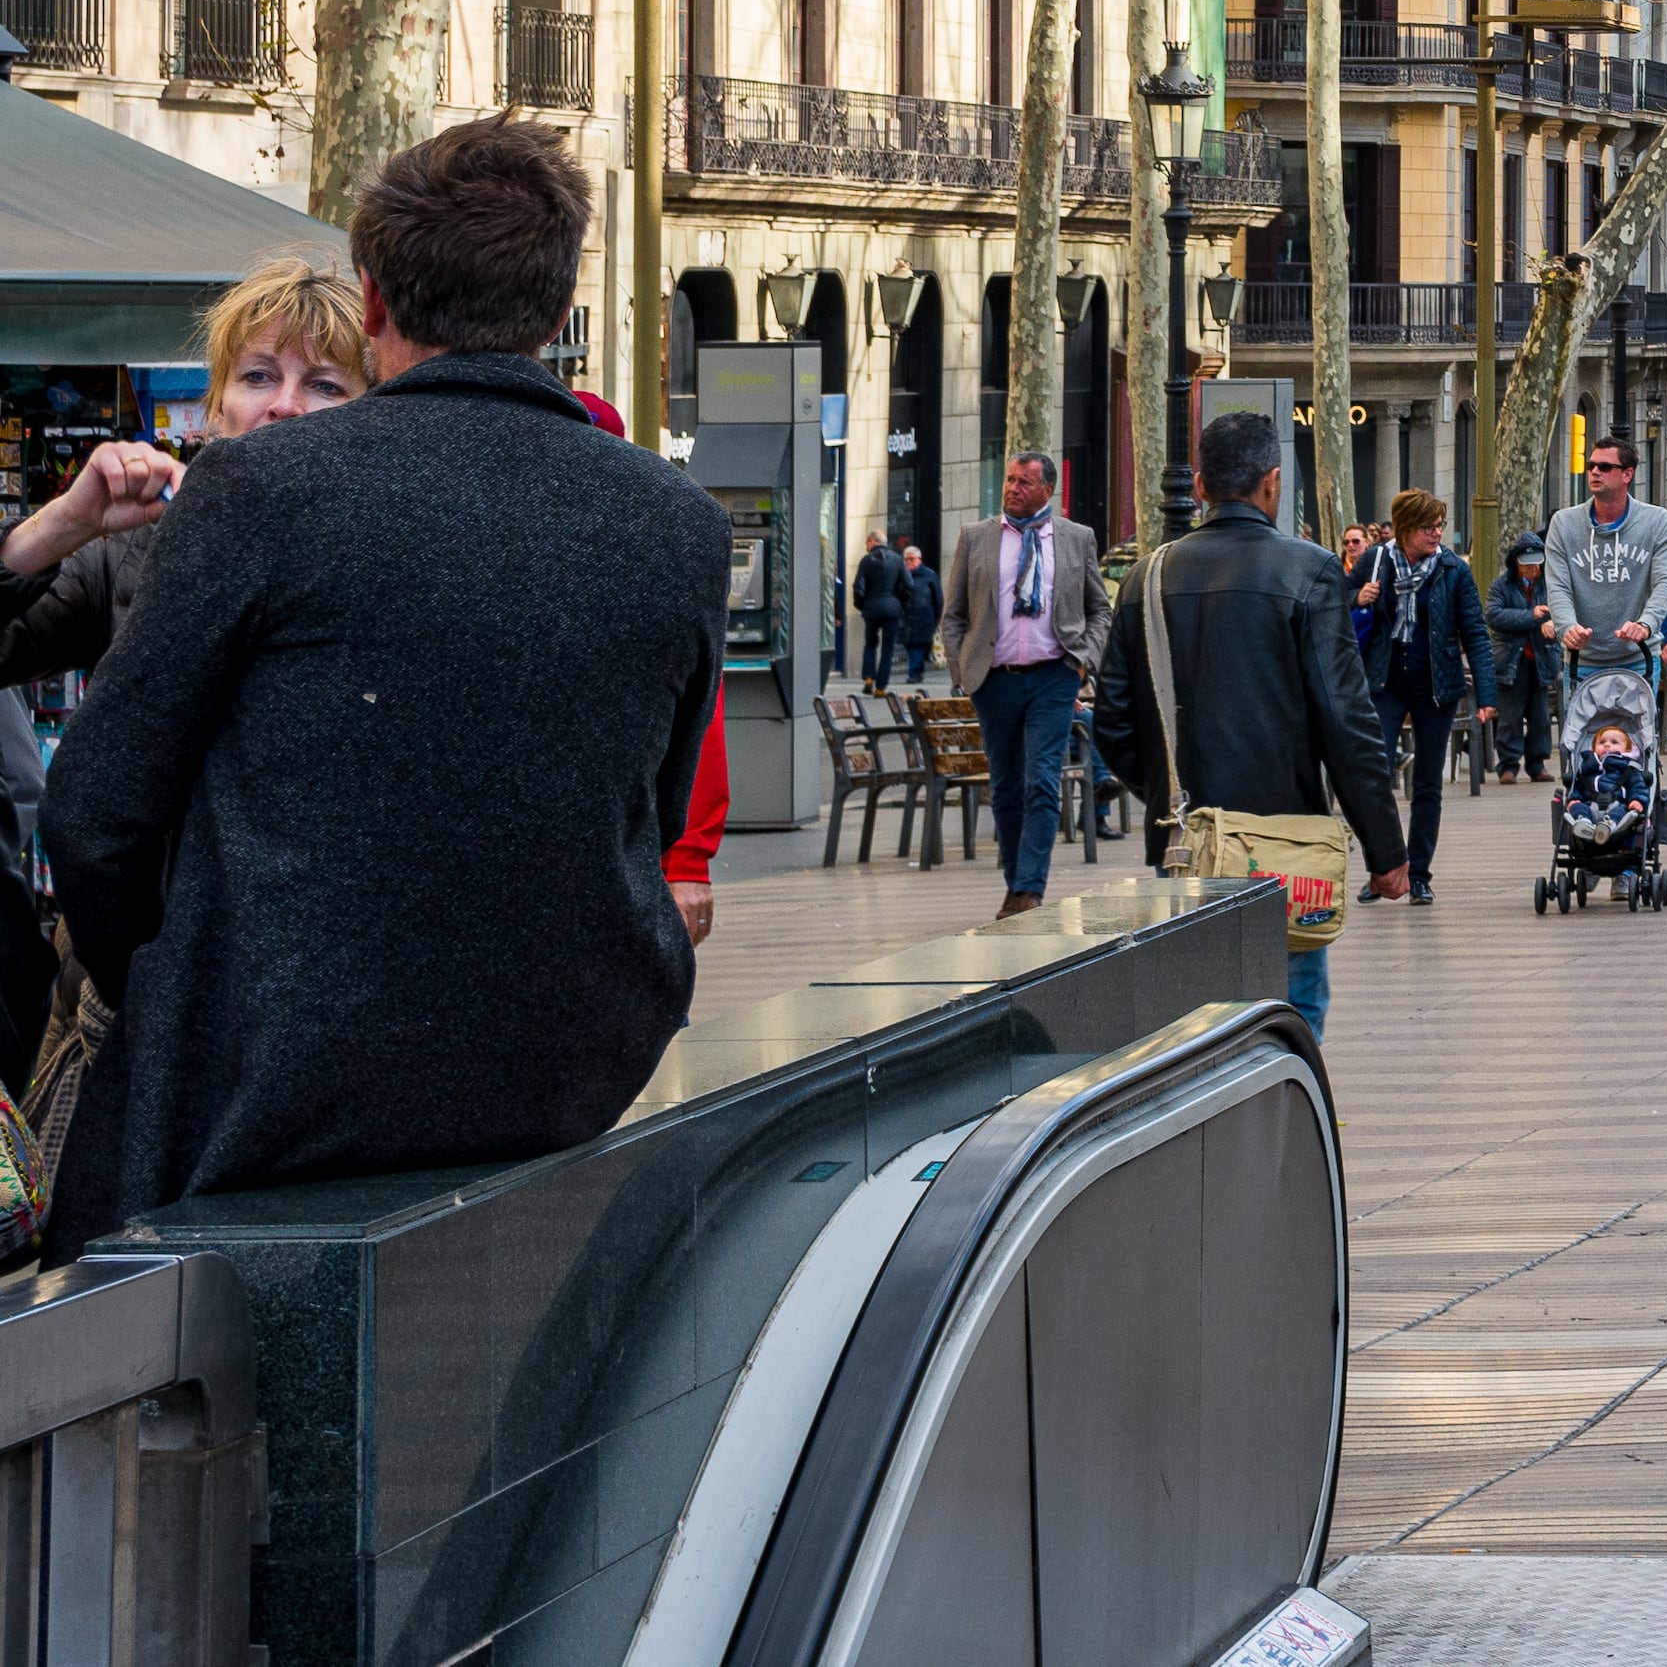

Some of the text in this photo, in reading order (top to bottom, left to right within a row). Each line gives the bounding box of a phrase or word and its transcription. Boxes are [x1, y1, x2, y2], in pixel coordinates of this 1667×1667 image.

[1571, 543, 1650, 568] VITAMIN
[1594, 567, 1631, 583] SEA
[1292, 875, 1333, 907] WITH
